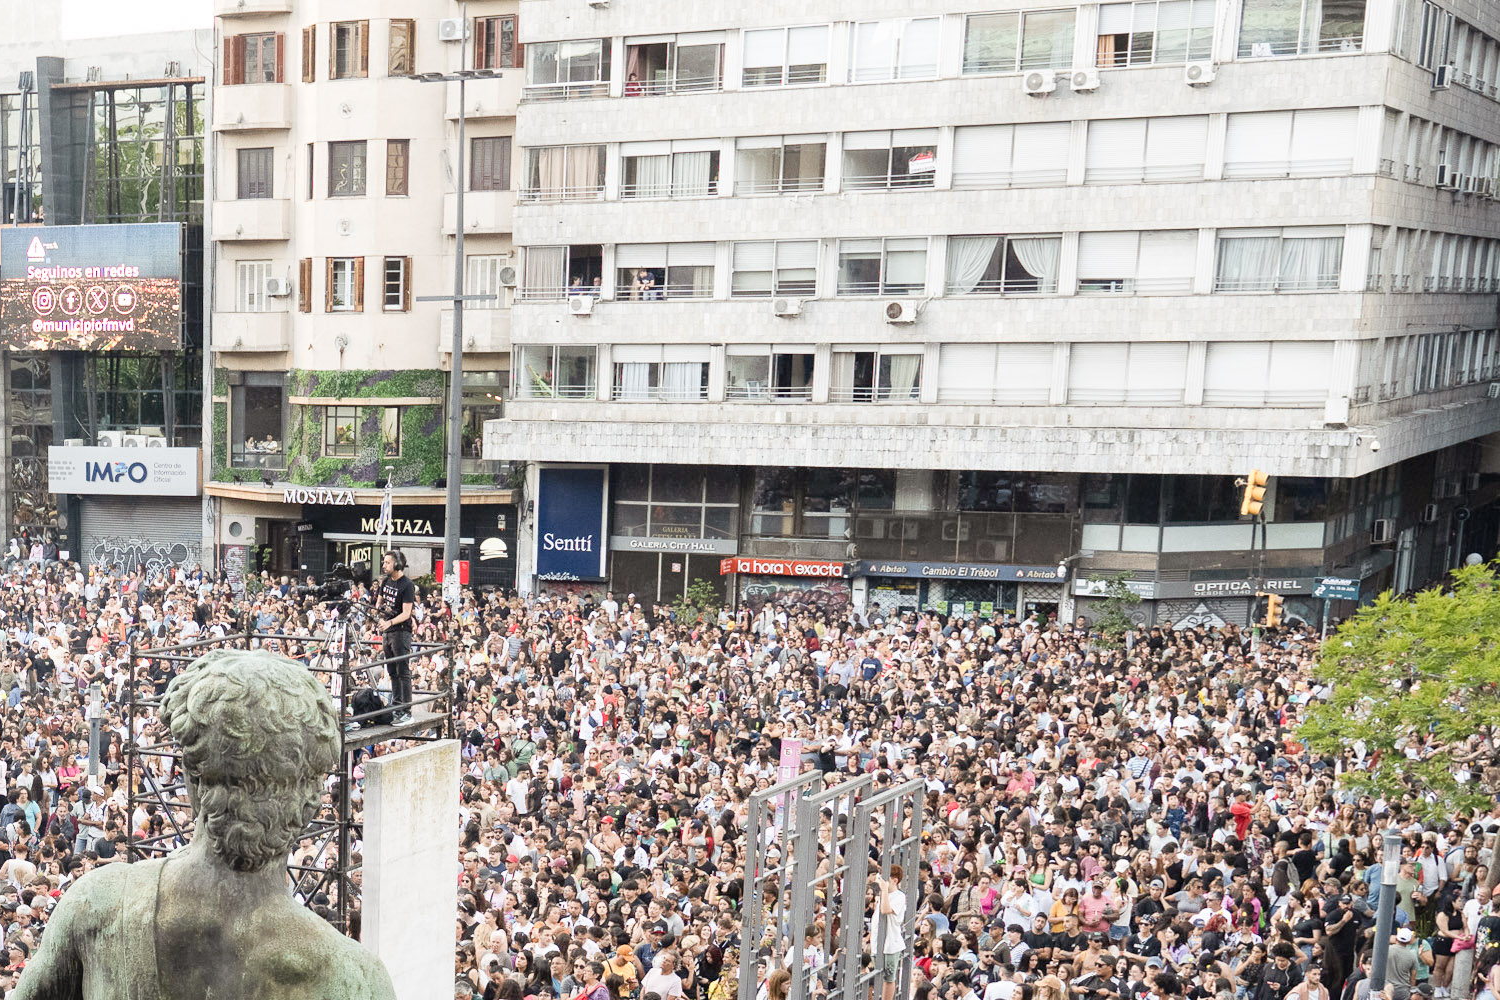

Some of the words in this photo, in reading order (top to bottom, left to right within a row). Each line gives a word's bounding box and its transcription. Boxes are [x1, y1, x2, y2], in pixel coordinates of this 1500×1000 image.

[27, 265, 82, 282] Seguinos
[84, 267, 101, 278] en
[103, 264, 139, 278] redes
[32, 318, 135, 334] @municipiofmvd
[283, 489, 356, 506] MOSTAZA
[737, 560, 750, 573] la
[753, 560, 784, 574] hora
[794, 563, 843, 577] exacta
[879, 565, 907, 573] Abitab
[922, 566, 957, 576] Cambio
[958, 566, 968, 576] El
[970, 567, 999, 578] Trébol
[1027, 570, 1056, 579] Abitab
[1194, 581, 1252, 592] OPTICA
